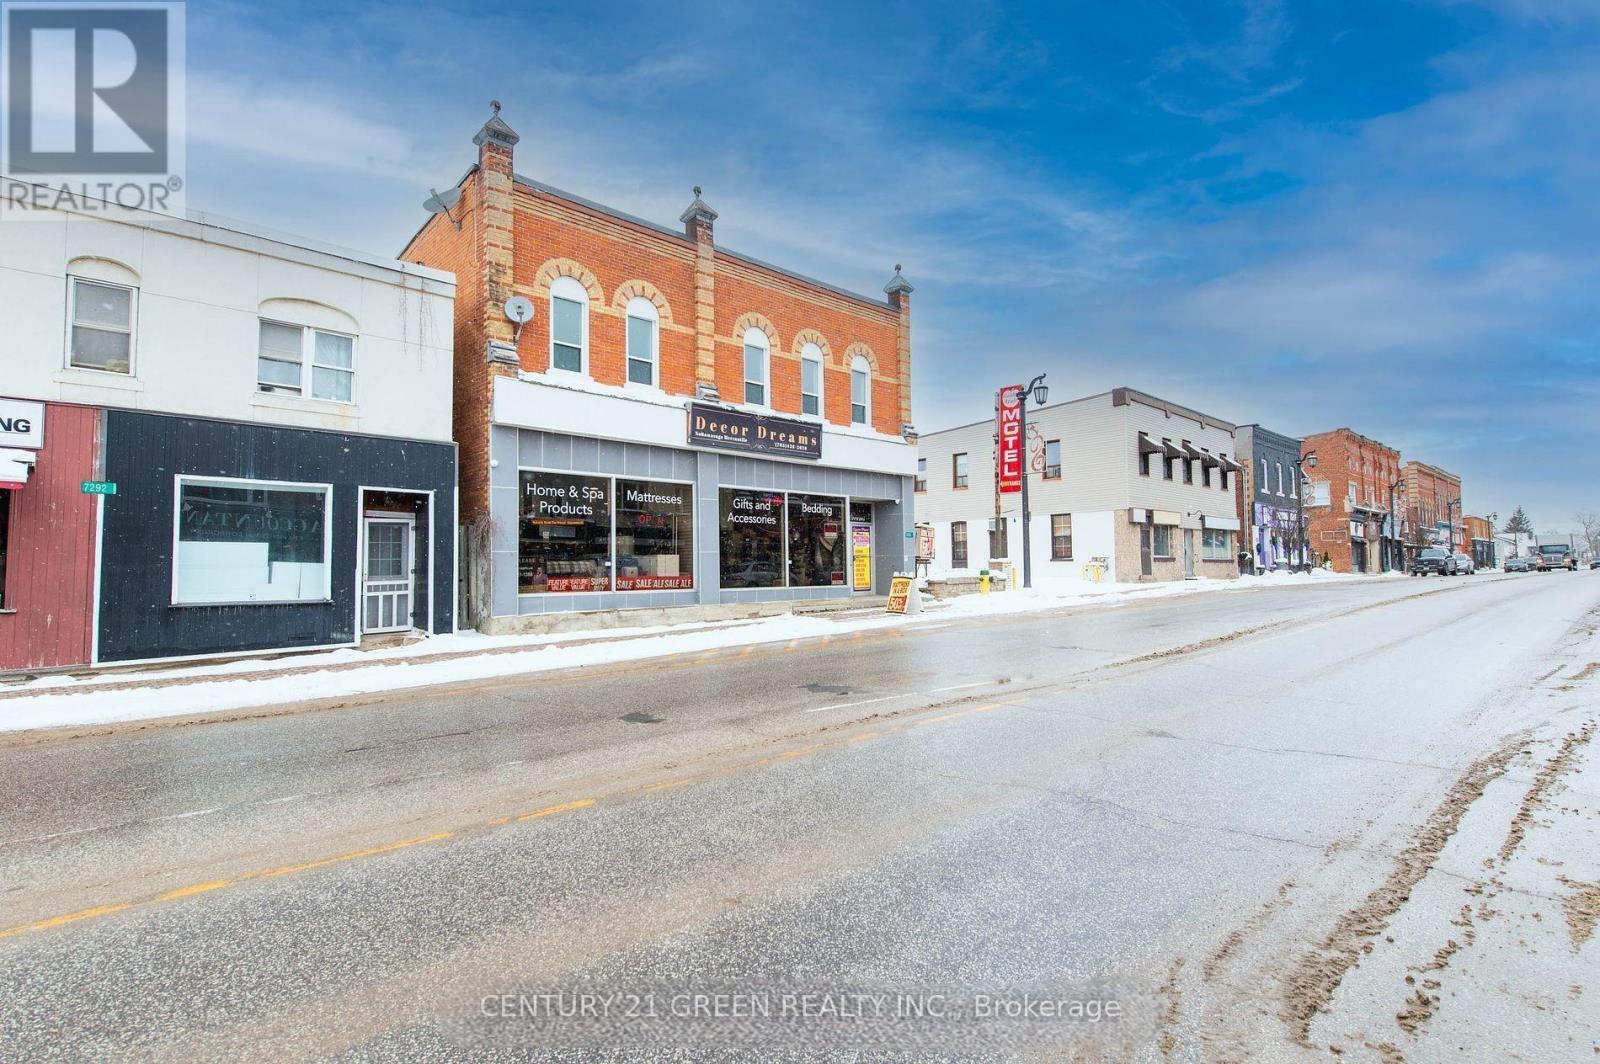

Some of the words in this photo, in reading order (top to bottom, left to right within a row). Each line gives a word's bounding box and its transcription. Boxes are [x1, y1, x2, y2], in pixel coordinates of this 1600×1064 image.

[696, 416, 749, 437] Decor
[757, 425, 817, 446] Dreams
[1002, 408, 1020, 477] MOTEL
[84, 482, 107, 492] 7292
[526, 483, 565, 498] Home
[569, 485, 578, 498] &
[582, 486, 604, 502] Spa
[627, 490, 682, 505] Mattresses
[733, 498, 754, 510] Gifts
[755, 500, 771, 511] and
[540, 501, 593, 515] Products
[802, 503, 833, 517] Bedding
[727, 512, 777, 525] Accessories
[591, 577, 609, 585] SUPER
[617, 579, 633, 589] SALE
[636, 579, 652, 588] SALE
[664, 579, 679, 588] SALE
